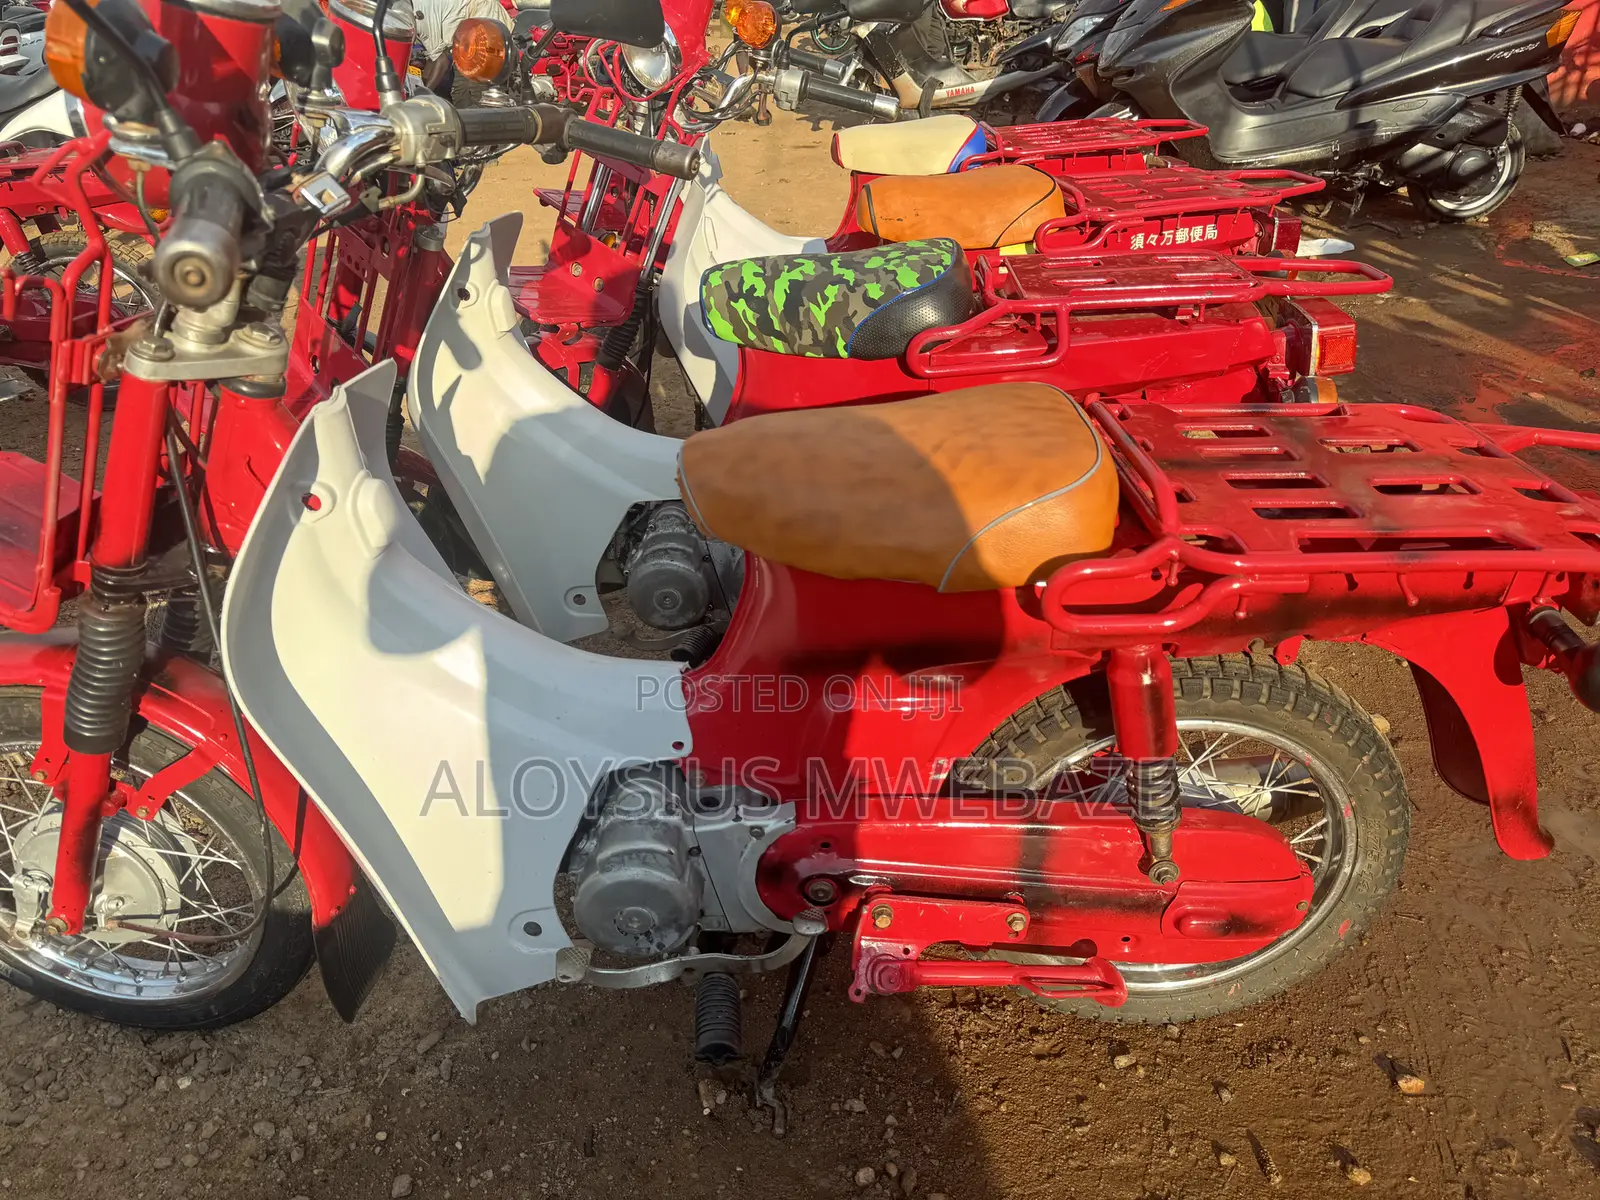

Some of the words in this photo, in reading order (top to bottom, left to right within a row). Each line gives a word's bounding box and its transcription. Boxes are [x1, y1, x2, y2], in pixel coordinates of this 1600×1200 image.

[945, 86, 975, 98] YAMAHA
[1130, 223, 1218, 251] 須々万郵便局
